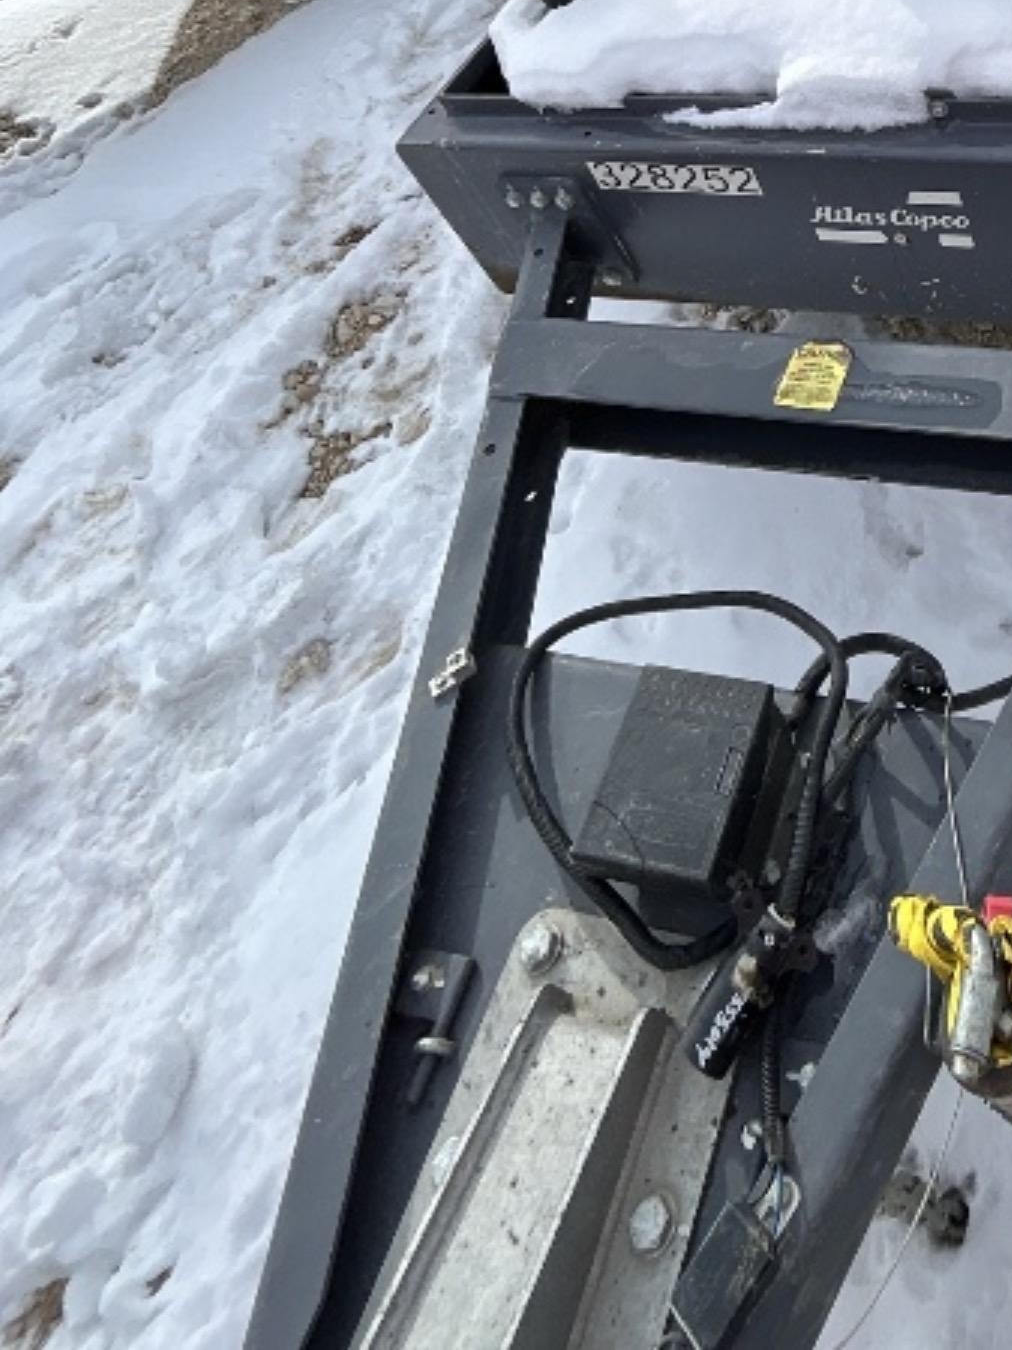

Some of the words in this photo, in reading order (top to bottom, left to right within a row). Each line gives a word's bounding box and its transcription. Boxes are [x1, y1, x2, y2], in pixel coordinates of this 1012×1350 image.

[592, 163, 762, 194] 328252
[810, 205, 887, 227] Atlas
[889, 208, 971, 233] Copco
